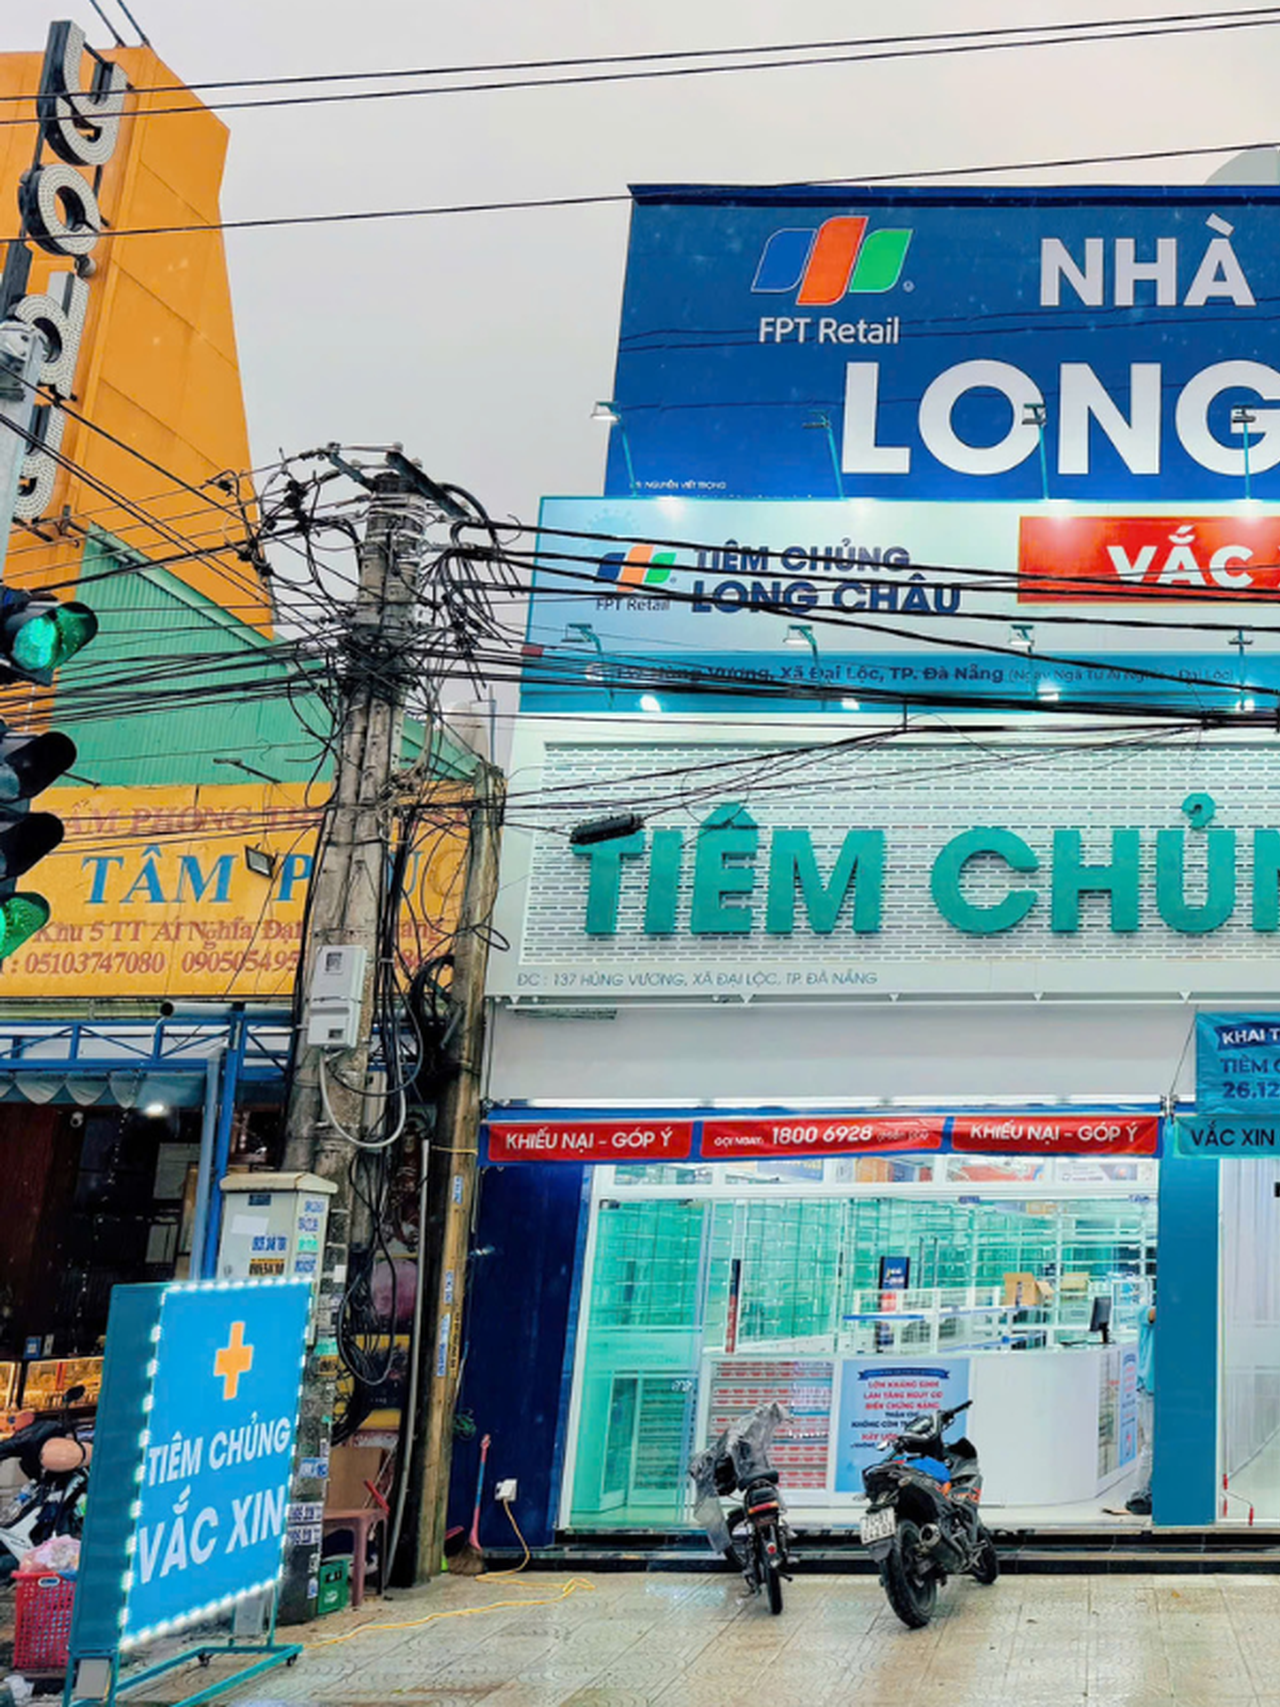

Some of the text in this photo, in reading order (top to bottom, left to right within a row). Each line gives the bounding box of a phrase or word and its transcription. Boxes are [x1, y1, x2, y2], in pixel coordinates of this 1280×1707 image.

[1040, 213, 1256, 306] NHÀ
[758, 318, 899, 345] FPT Retail
[694, 538, 910, 572] TIÊM CHỦNG
[1107, 525, 1253, 587] VẮC
[692, 572, 961, 614] LONG CHÂU
[889, 668, 914, 680] TP.
[923, 666, 949, 680] Đà
[81, 843, 238, 905] TÂM
[572, 801, 884, 936] TIÊM
[90, 921, 104, 942] 5
[25, 950, 165, 975] 05103747080
[553, 973, 576, 987] 137
[580, 969, 624, 987] HÙNG
[693, 969, 714, 986] XÃ
[1222, 1028, 1266, 1045] KHAI
[1221, 1054, 1267, 1074] TIÊM
[505, 1124, 558, 1149] KHIẾU
[563, 1131, 594, 1152] NẠI
[611, 1126, 654, 1148] GÓP
[658, 1126, 673, 1147] Ý
[772, 1126, 817, 1144] 1800
[822, 1126, 872, 1143] 6928
[969, 1120, 1021, 1142] KHIẾU
[1026, 1125, 1060, 1145] NẠI
[1078, 1122, 1120, 1143] GÓP
[1123, 1122, 1138, 1143] Ý
[1190, 1121, 1235, 1147] VẮC
[1241, 1128, 1275, 1147] XIN
[148, 1430, 204, 1487] TIÊM
[208, 1410, 291, 1471] CHỦNG
[139, 1484, 219, 1585] VẮC
[225, 1484, 286, 1555] XIN
